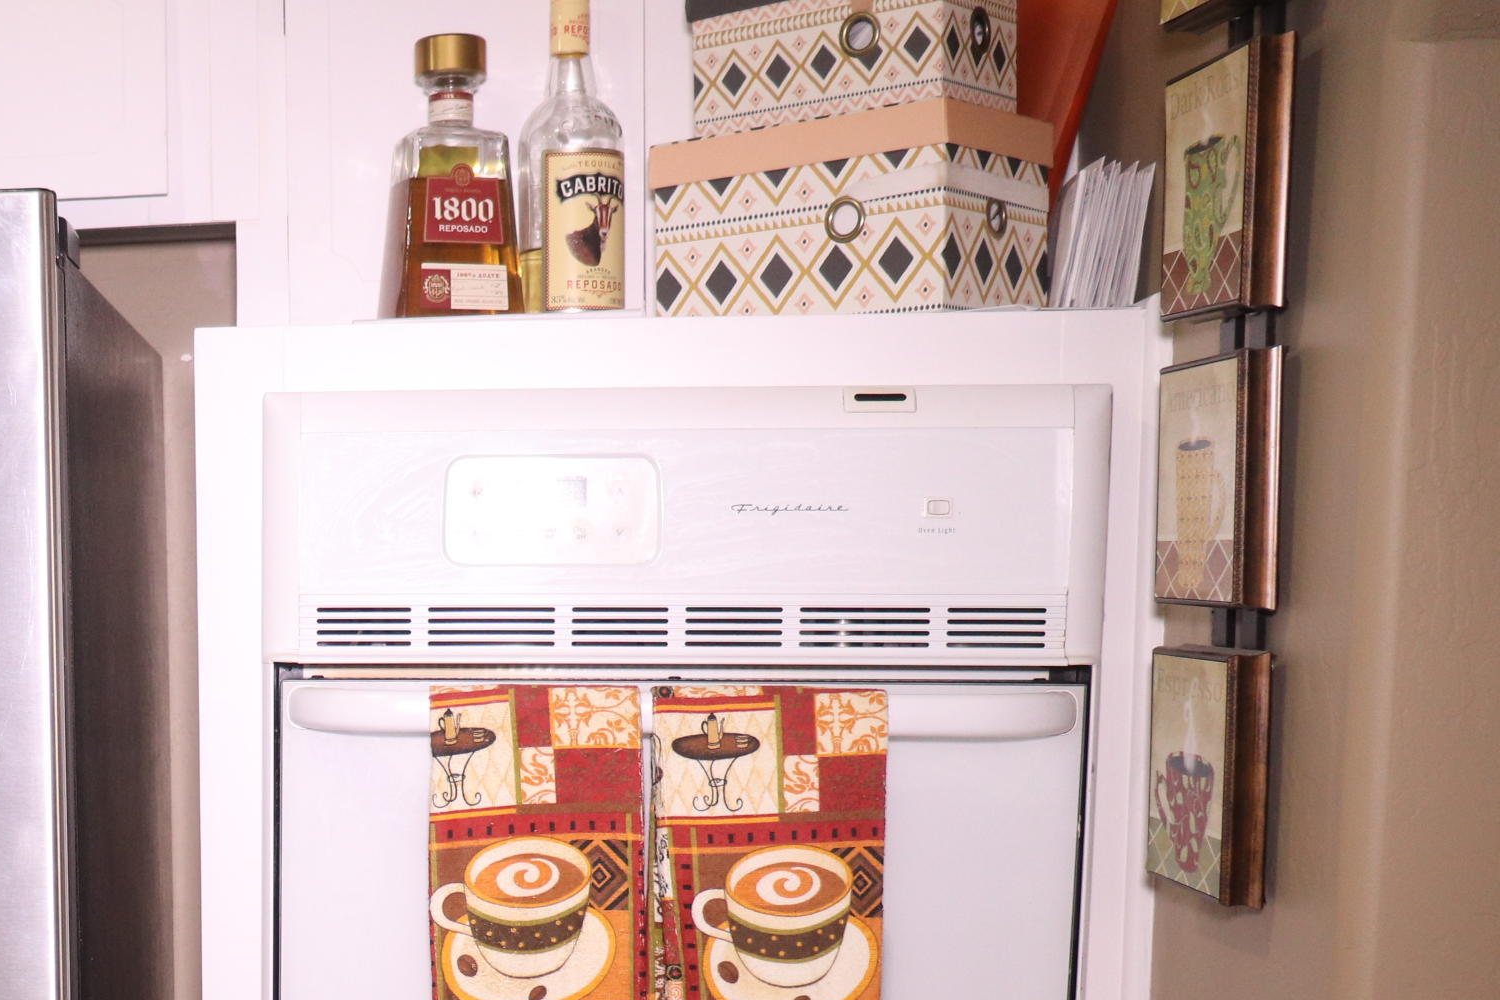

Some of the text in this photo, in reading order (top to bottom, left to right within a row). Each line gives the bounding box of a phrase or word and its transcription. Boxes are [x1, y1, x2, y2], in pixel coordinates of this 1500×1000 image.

[560, 176, 623, 200] CABRITO
[433, 196, 494, 222] 1800
[438, 224, 488, 233] REPOSADO
[567, 279, 621, 291] REPOSADO
[730, 503, 849, 516] Frigidaire
